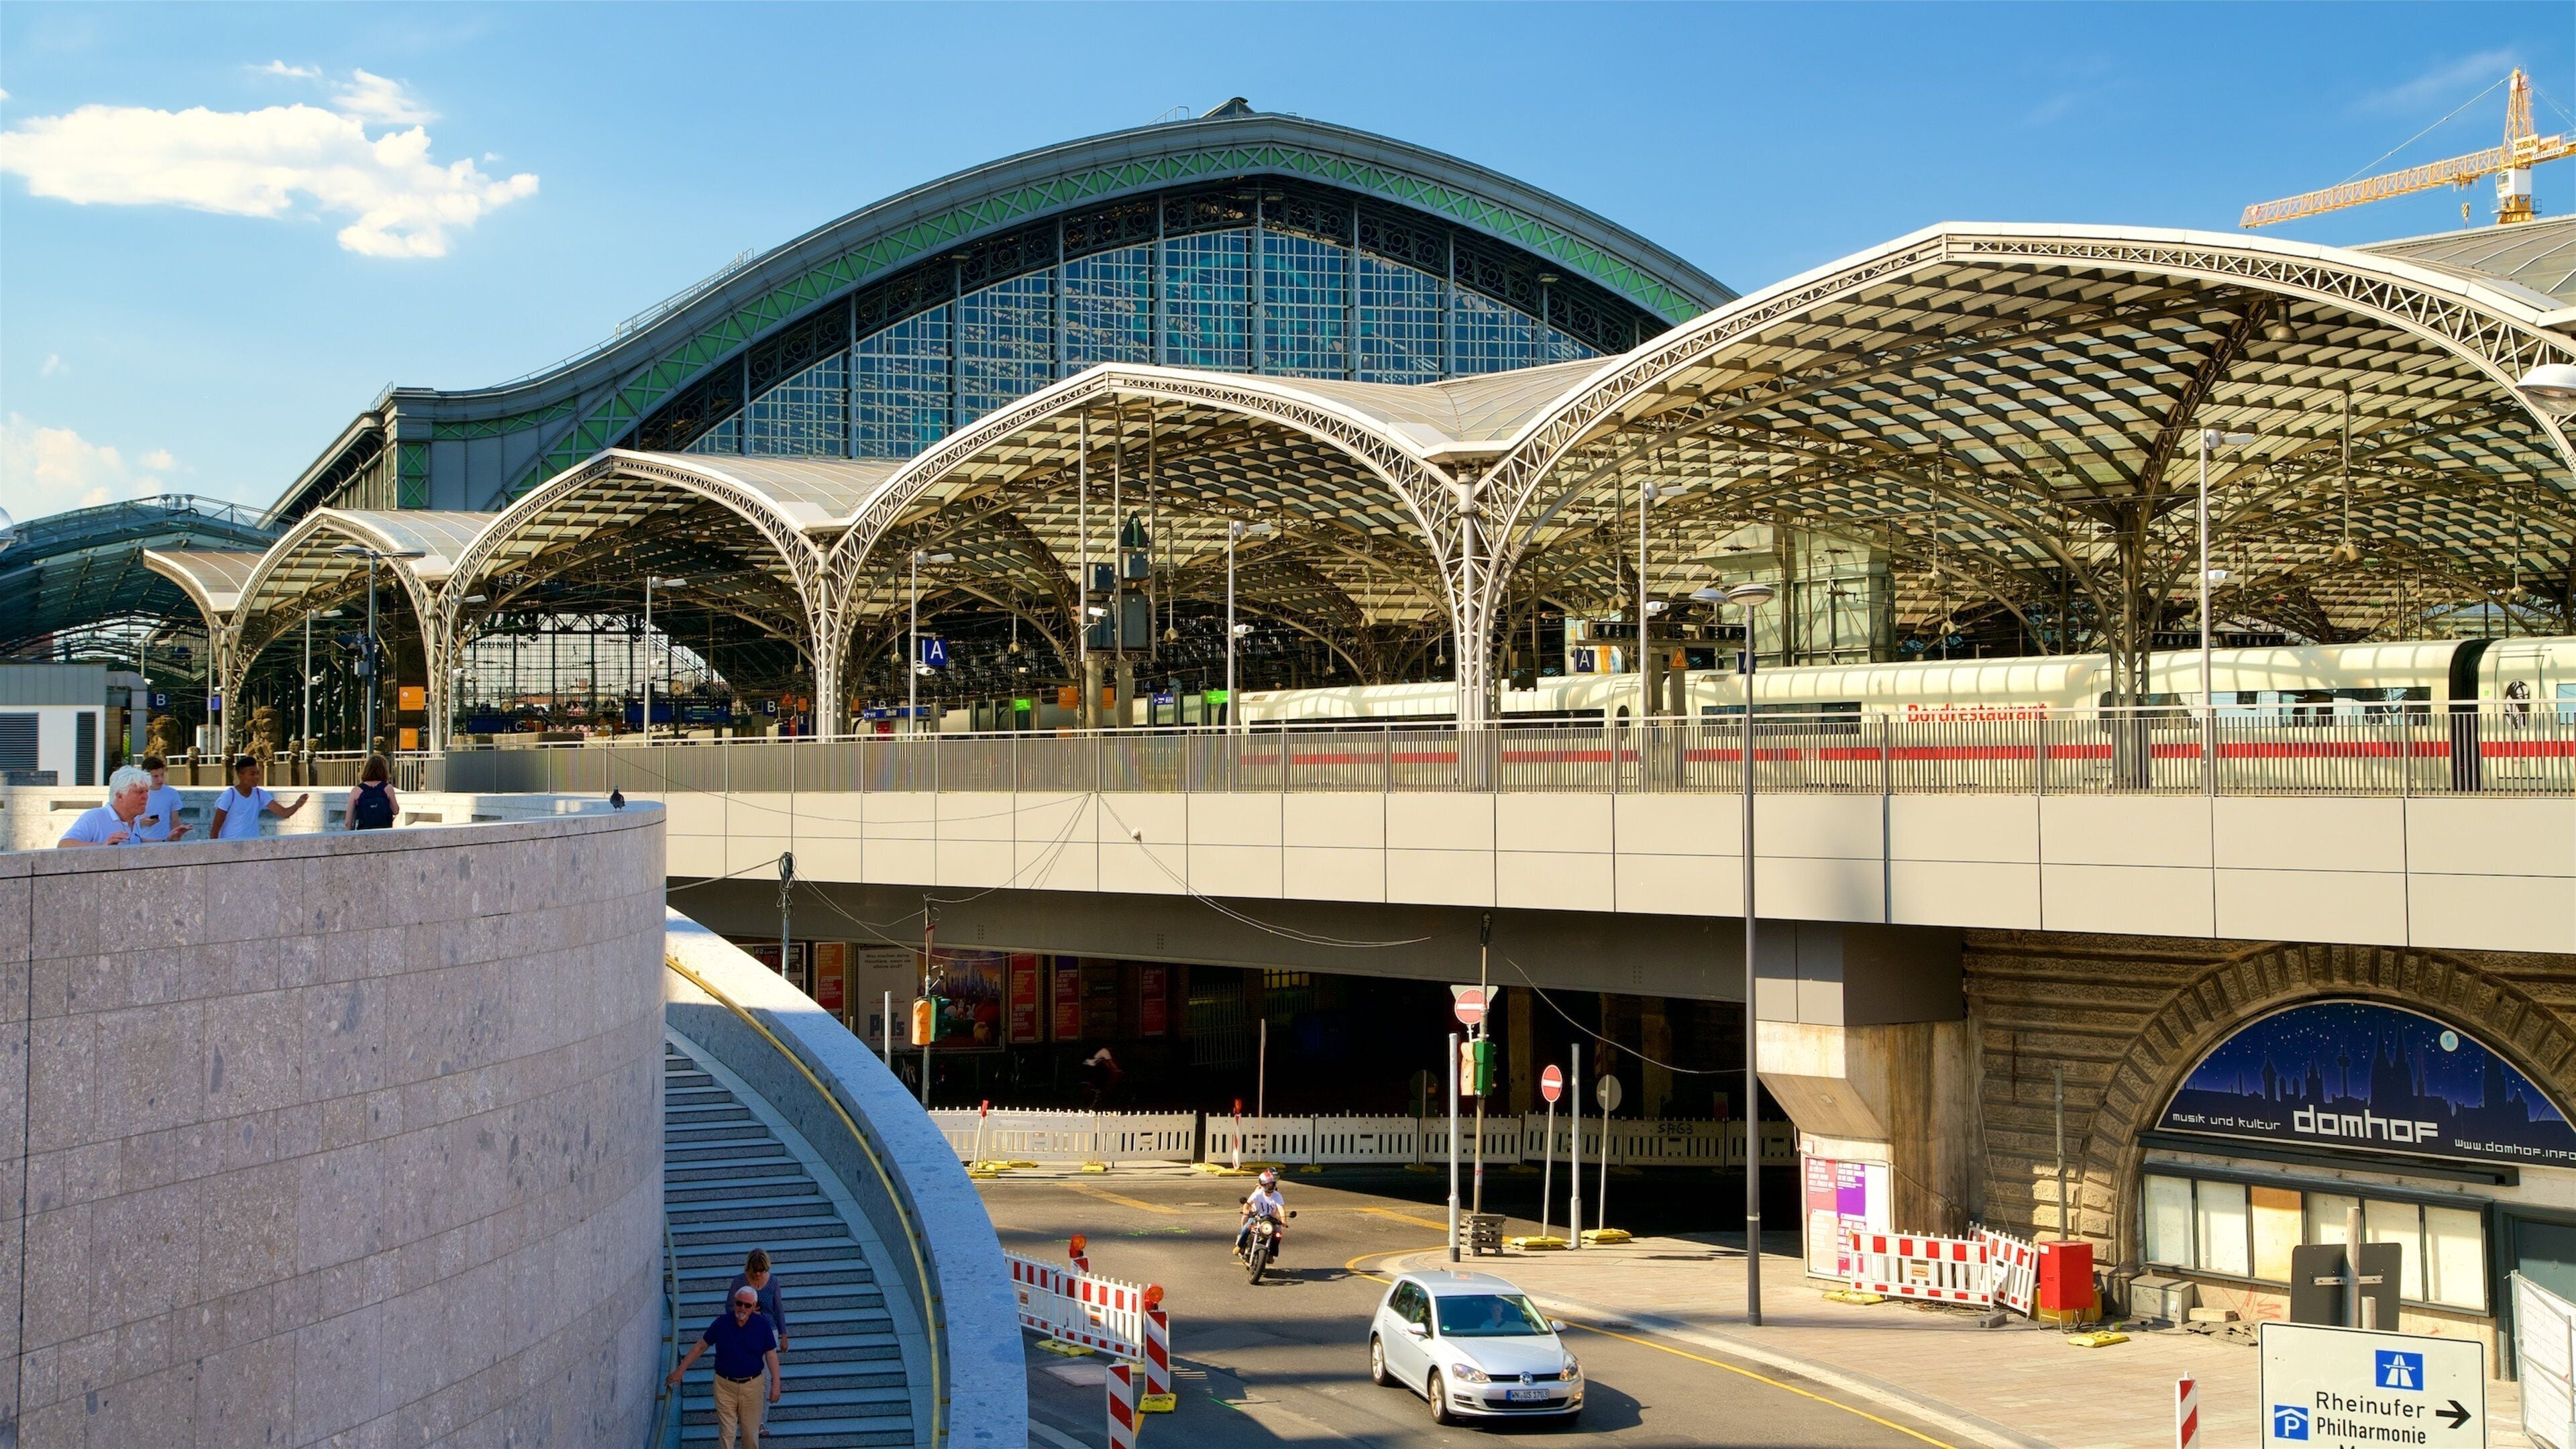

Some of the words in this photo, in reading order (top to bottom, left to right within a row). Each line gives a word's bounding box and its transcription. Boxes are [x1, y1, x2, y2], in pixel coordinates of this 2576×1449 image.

[930, 640, 944, 659] A
[1578, 650, 1591, 668] A
[155, 693, 167, 706] B
[767, 700, 776, 713] B
[1907, 702, 2047, 722] Bordrestaurant
[515, 721, 523, 731] C
[2172, 1112, 2206, 1124] musik
[2210, 1116, 2235, 1127] und
[2238, 1118, 2282, 1131] kultur
[2292, 1104, 2439, 1144] domhof
[2454, 1138, 2576, 1161] www.domhof.info
[2316, 1391, 2426, 1419] Rheinufer
[2284, 1416, 2300, 1437] P
[2316, 1416, 2426, 1444] Philharmonie
